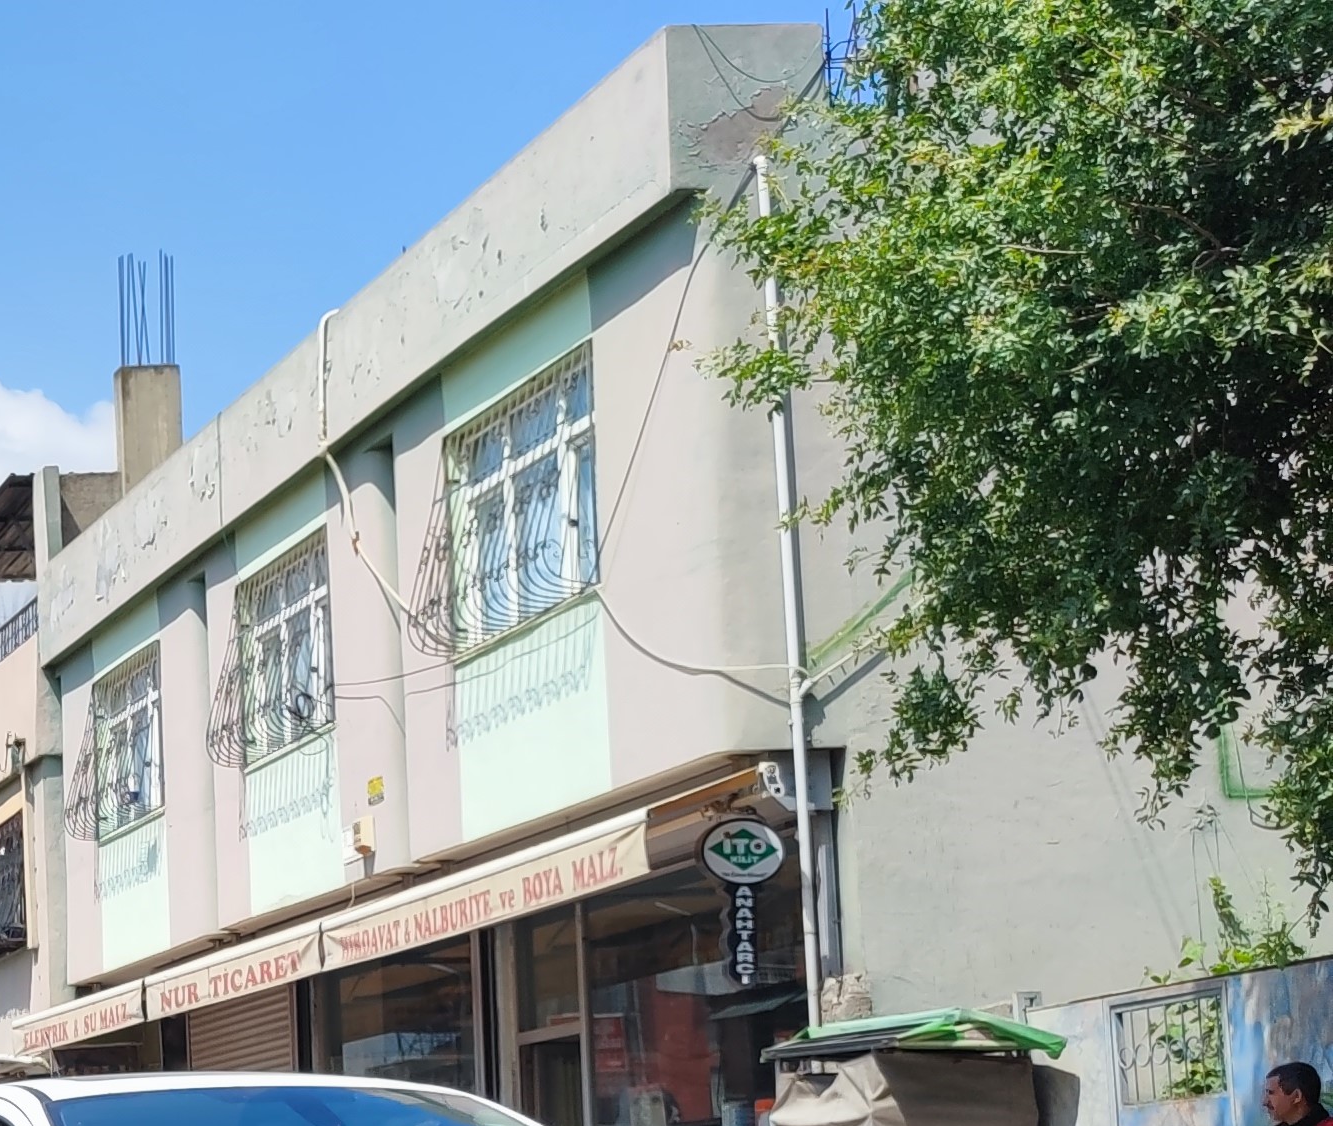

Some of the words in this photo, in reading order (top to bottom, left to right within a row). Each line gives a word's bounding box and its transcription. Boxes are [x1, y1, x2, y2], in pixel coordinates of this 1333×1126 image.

[521, 866, 564, 906] BOYA
[571, 846, 624, 892] MALZ.
[160, 982, 200, 1012] NUR
[209, 950, 302, 999] TİCARET
[84, 1012, 97, 1035] SU
